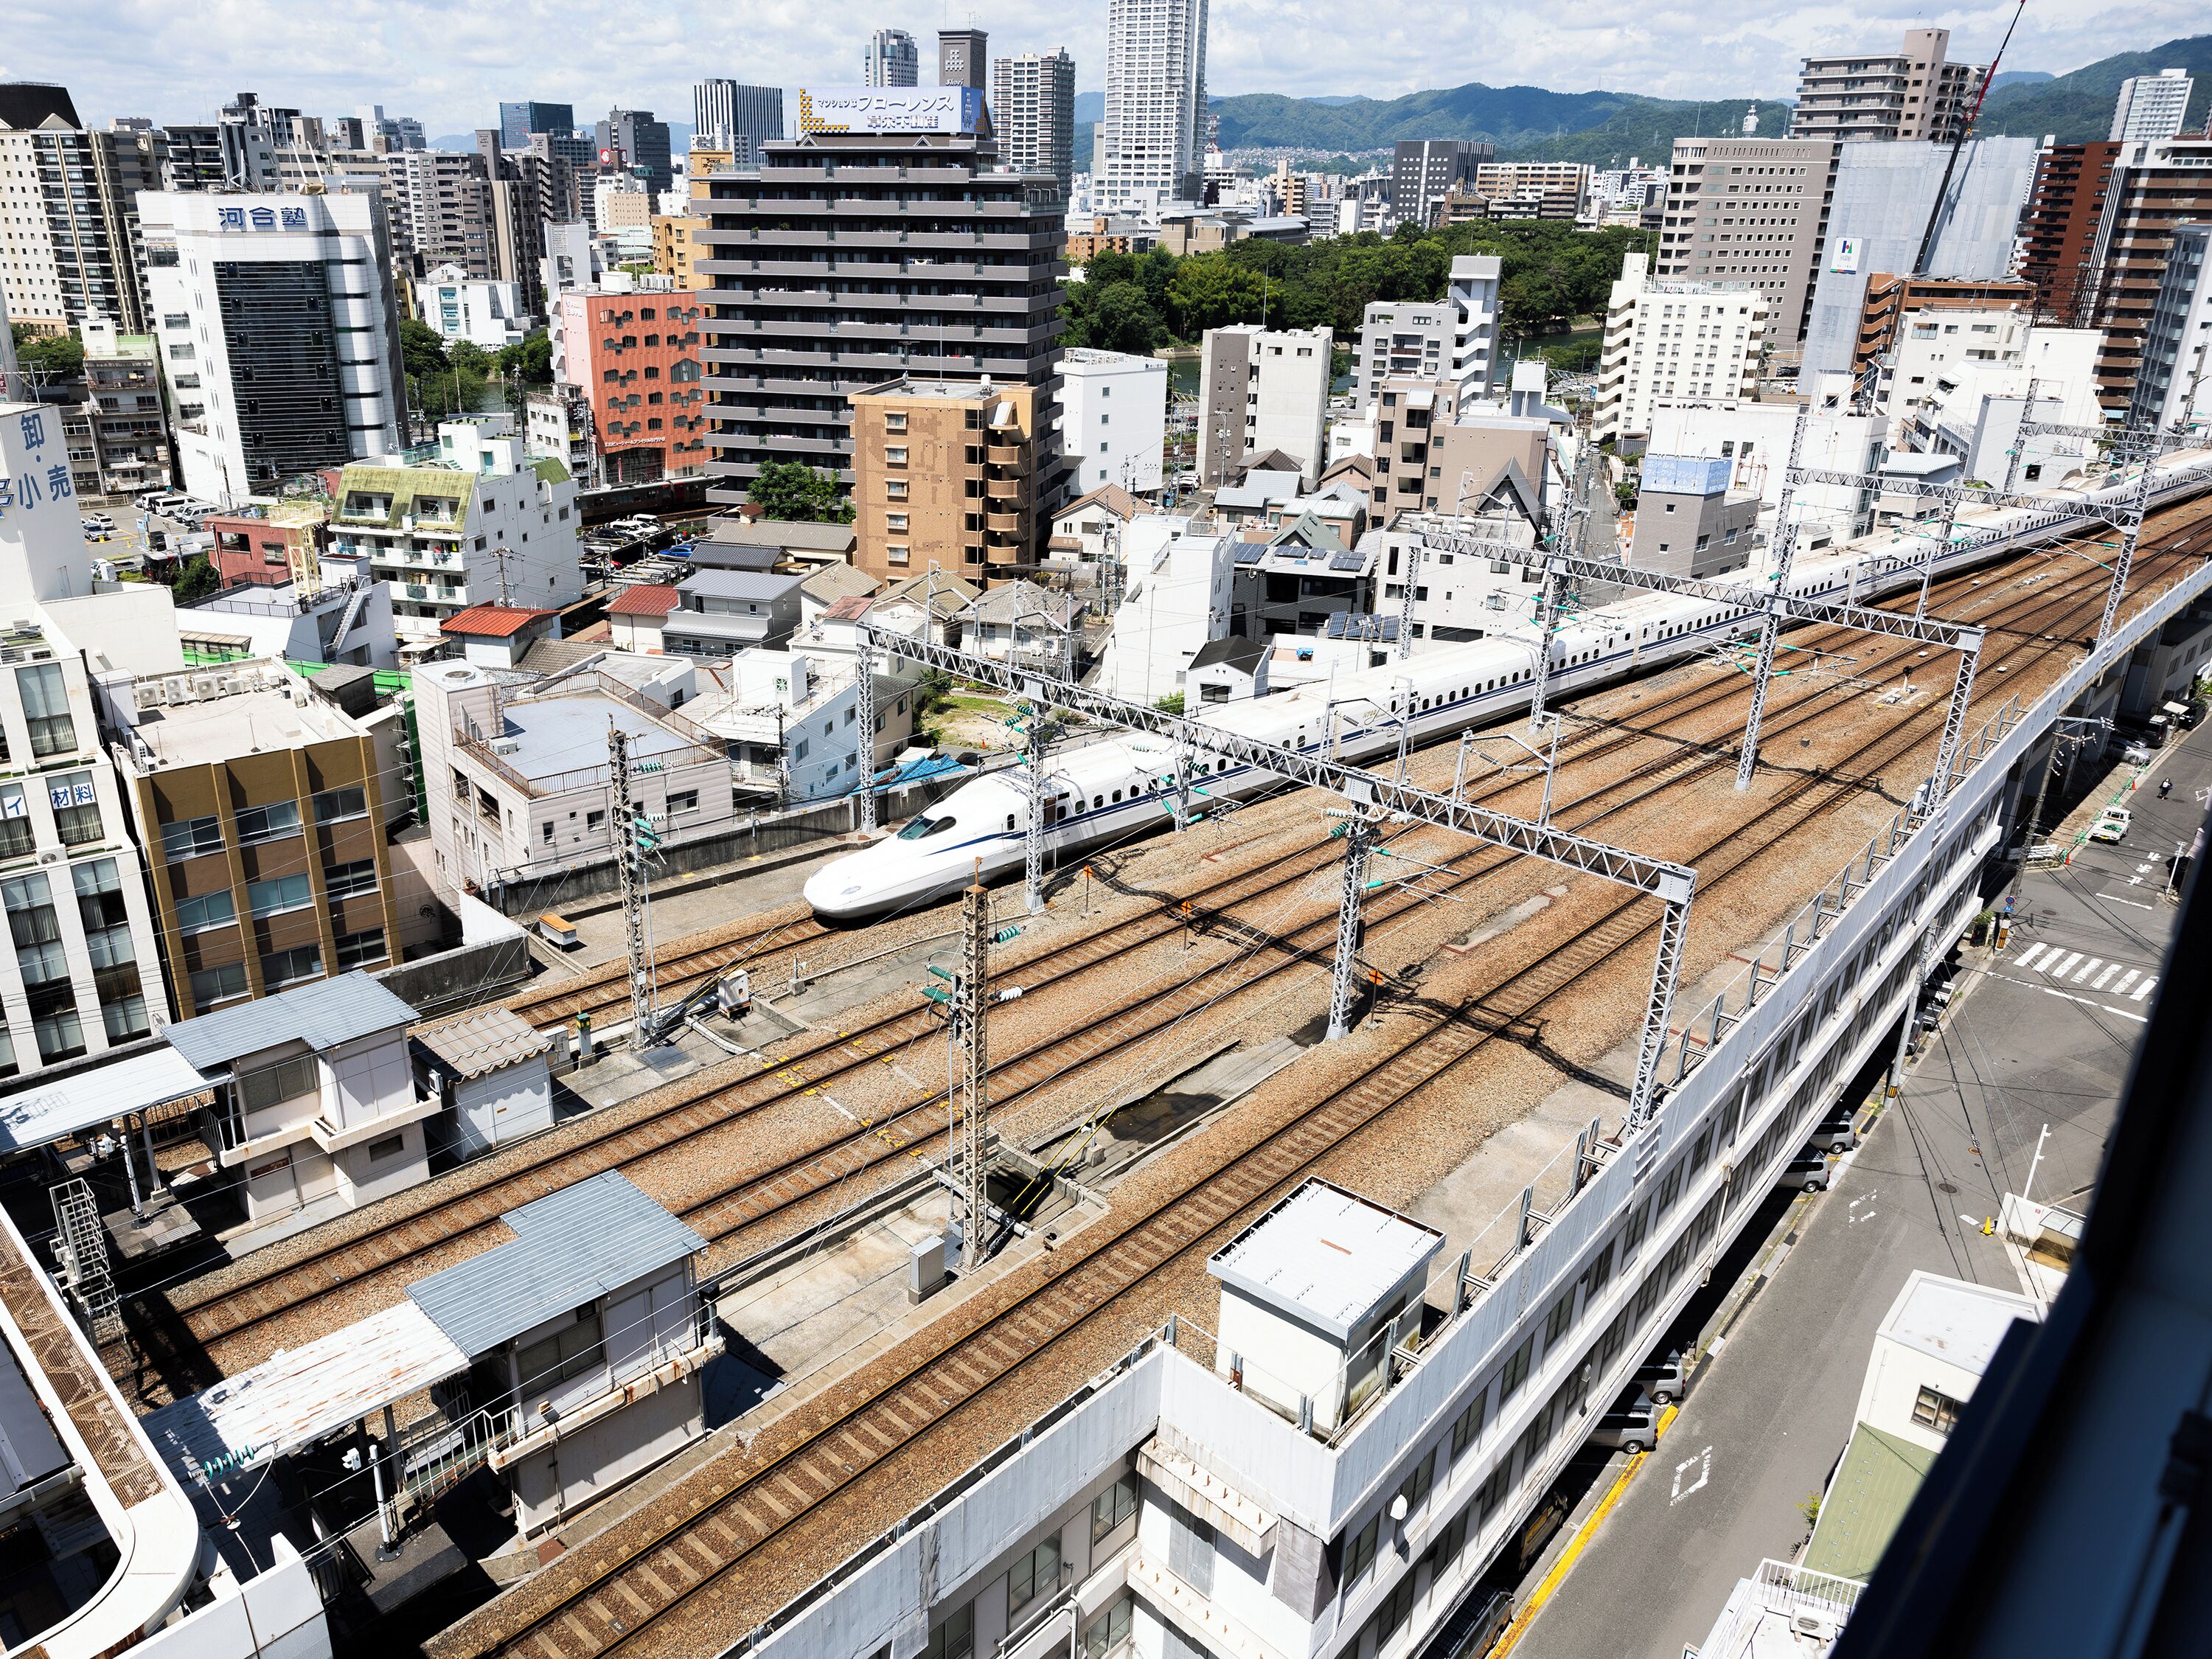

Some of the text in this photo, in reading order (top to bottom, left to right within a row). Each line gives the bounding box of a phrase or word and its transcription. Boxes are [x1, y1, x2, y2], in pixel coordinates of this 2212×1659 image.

[218, 206, 308, 227] 河合塾
[52, 784, 93, 808] 材料
[2127, 852, 2161, 886] 止まれ
